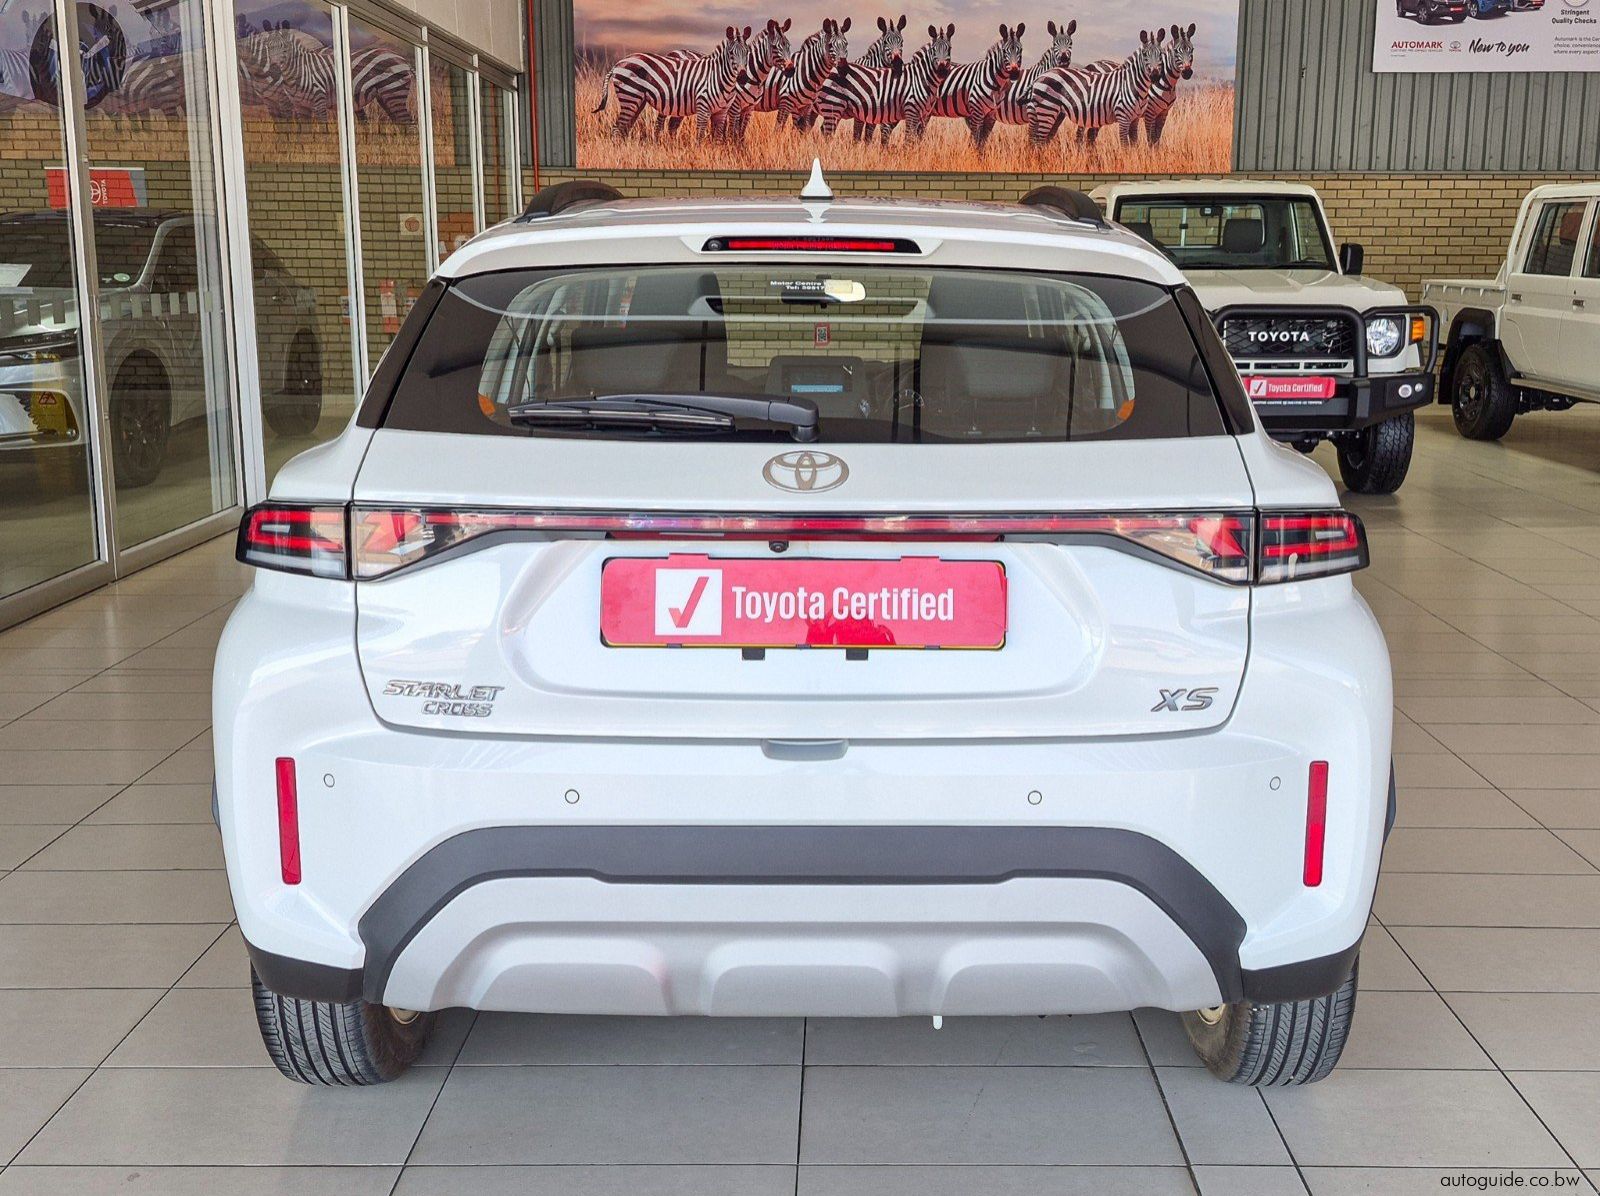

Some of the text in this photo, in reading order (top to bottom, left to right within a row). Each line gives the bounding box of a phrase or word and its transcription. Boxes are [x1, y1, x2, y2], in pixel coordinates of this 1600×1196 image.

[1391, 41, 1443, 49] AUTOMARK
[1468, 38, 1494, 53] New
[1507, 43, 1530, 57] you
[1248, 331, 1310, 342] TOYOTA
[1268, 383, 1323, 393] Toyota Certified
[732, 586, 954, 622] Toyota Certified
[383, 680, 505, 701] STARLET
[1151, 687, 1219, 712] XS
[422, 700, 494, 718] CROSS
